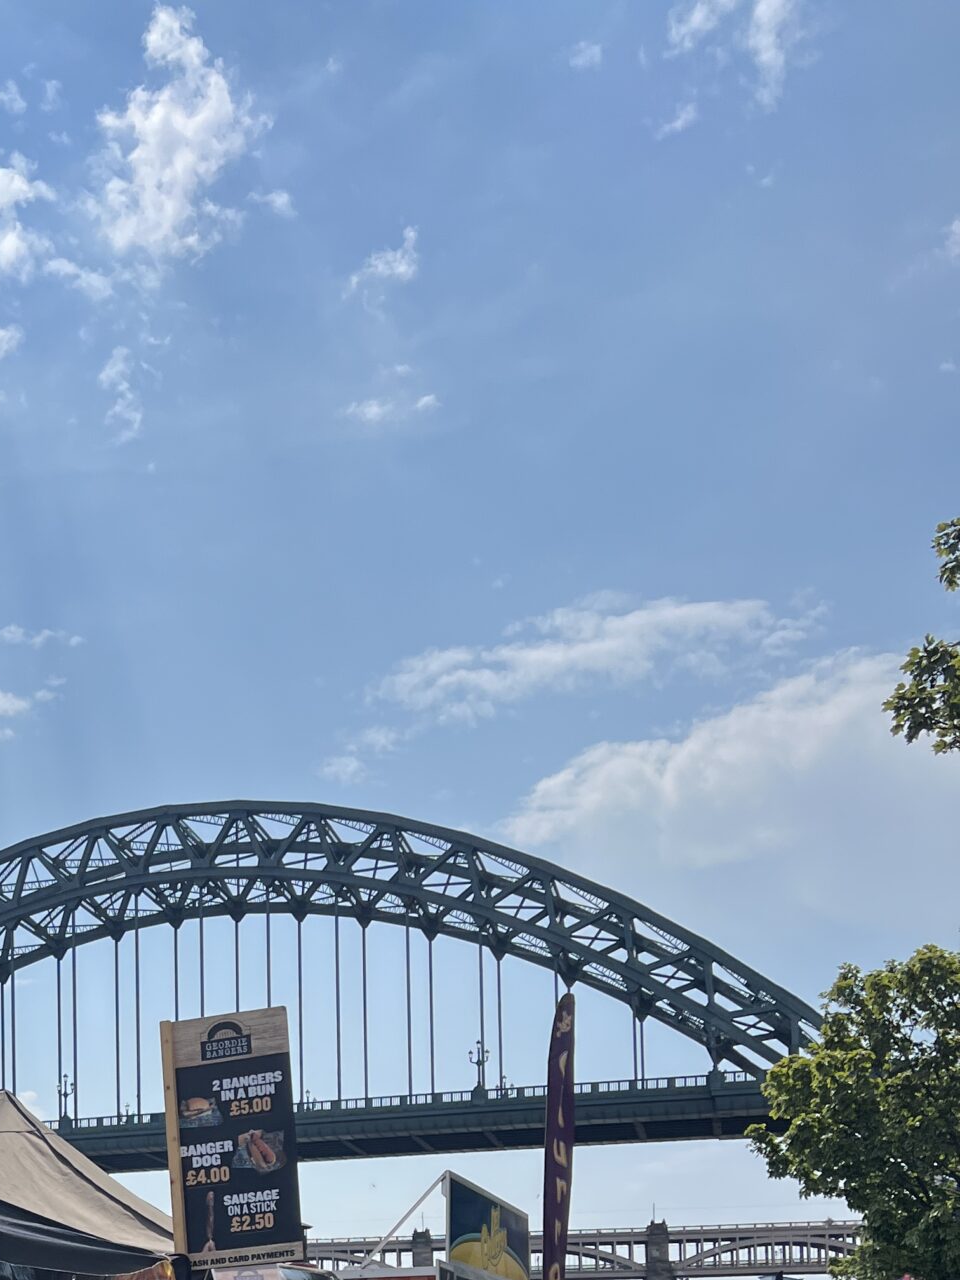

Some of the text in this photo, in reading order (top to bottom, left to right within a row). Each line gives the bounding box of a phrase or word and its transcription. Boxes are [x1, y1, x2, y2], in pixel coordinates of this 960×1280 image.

[205, 1037, 248, 1051] GEORDIE
[206, 1046, 248, 1059] BANGERS
[212, 1071, 283, 1092] 2 BANGERS
[220, 1083, 275, 1102] IN A BUN
[229, 1096, 272, 1117] £5.00
[180, 1140, 233, 1158] BANGER
[192, 1153, 221, 1168] DOG
[186, 1166, 230, 1186] £4.00
[223, 1188, 280, 1206] SAUSAGE
[227, 1199, 277, 1217] ON A STICK
[230, 1212, 274, 1233] £2.50
[211, 1257, 227, 1266] AND
[227, 1254, 250, 1264] CARD
[251, 1249, 295, 1262] PAYMENTS
